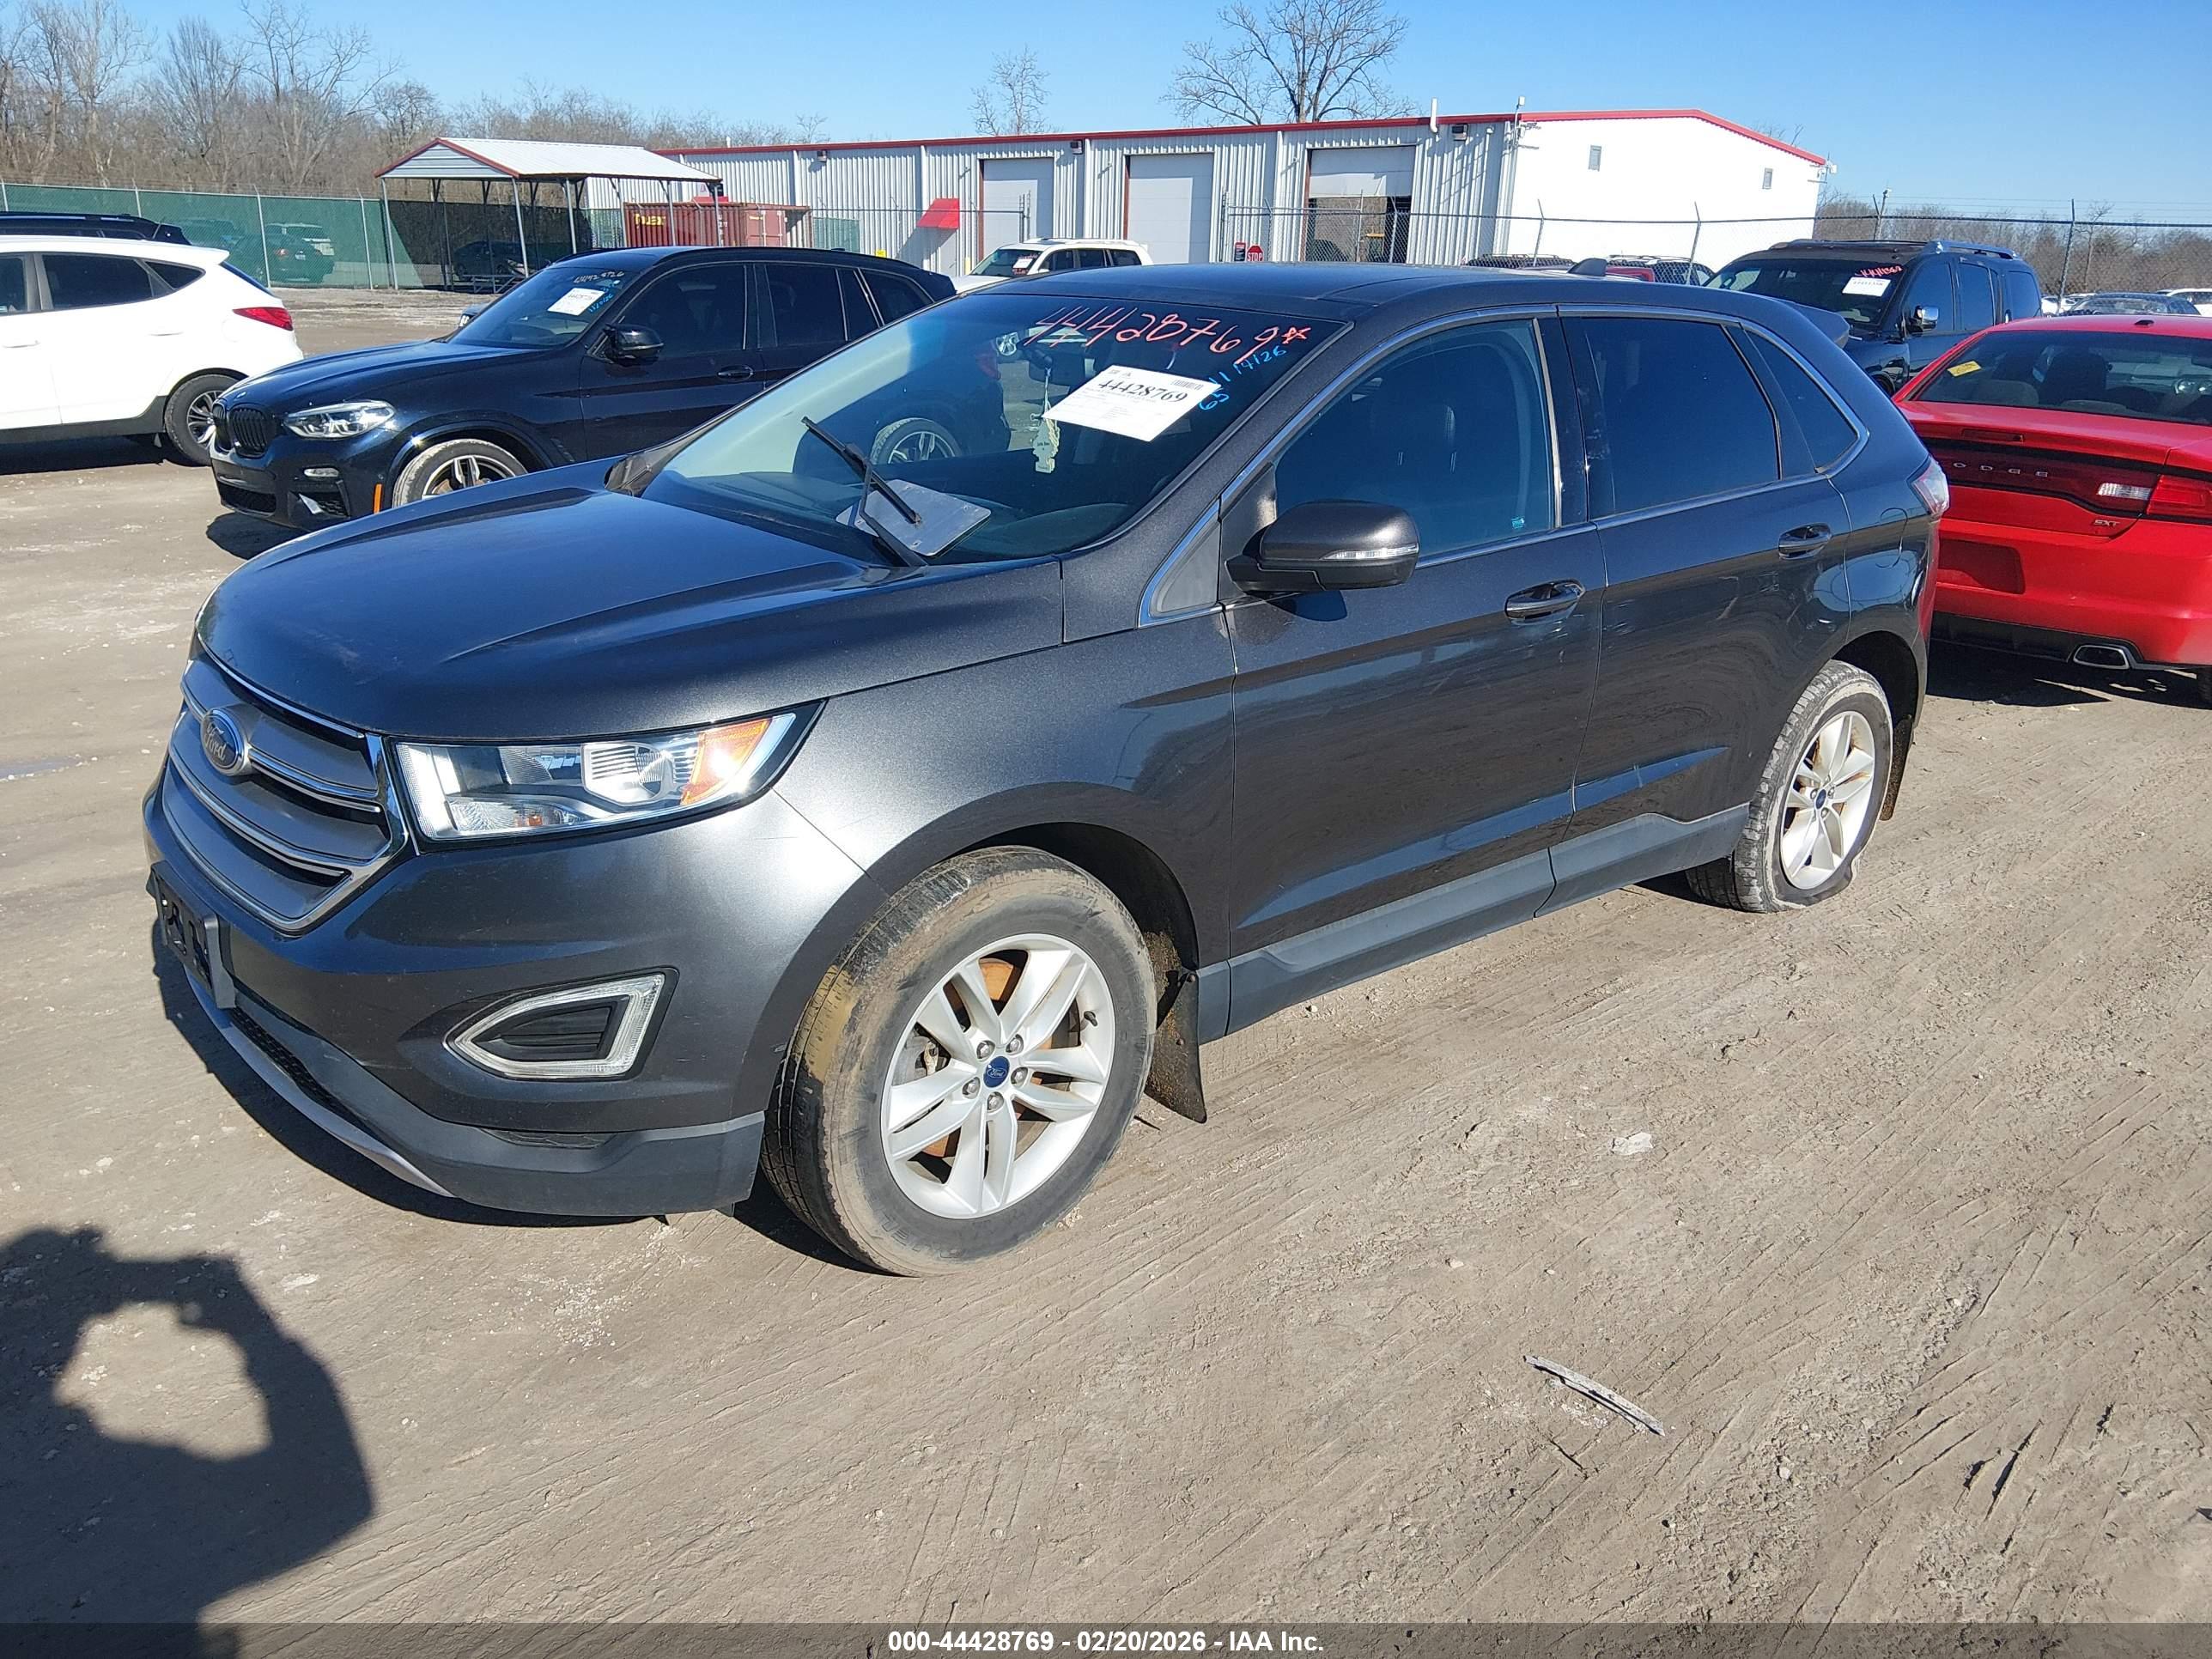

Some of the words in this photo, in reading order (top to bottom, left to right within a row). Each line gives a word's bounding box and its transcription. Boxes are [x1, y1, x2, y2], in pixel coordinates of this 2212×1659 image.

[1247, 252, 1263, 261] STOP
[1099, 380, 1188, 403] 44428769
[1953, 462, 2048, 477] ODGE
[205, 722, 226, 761] Ford
